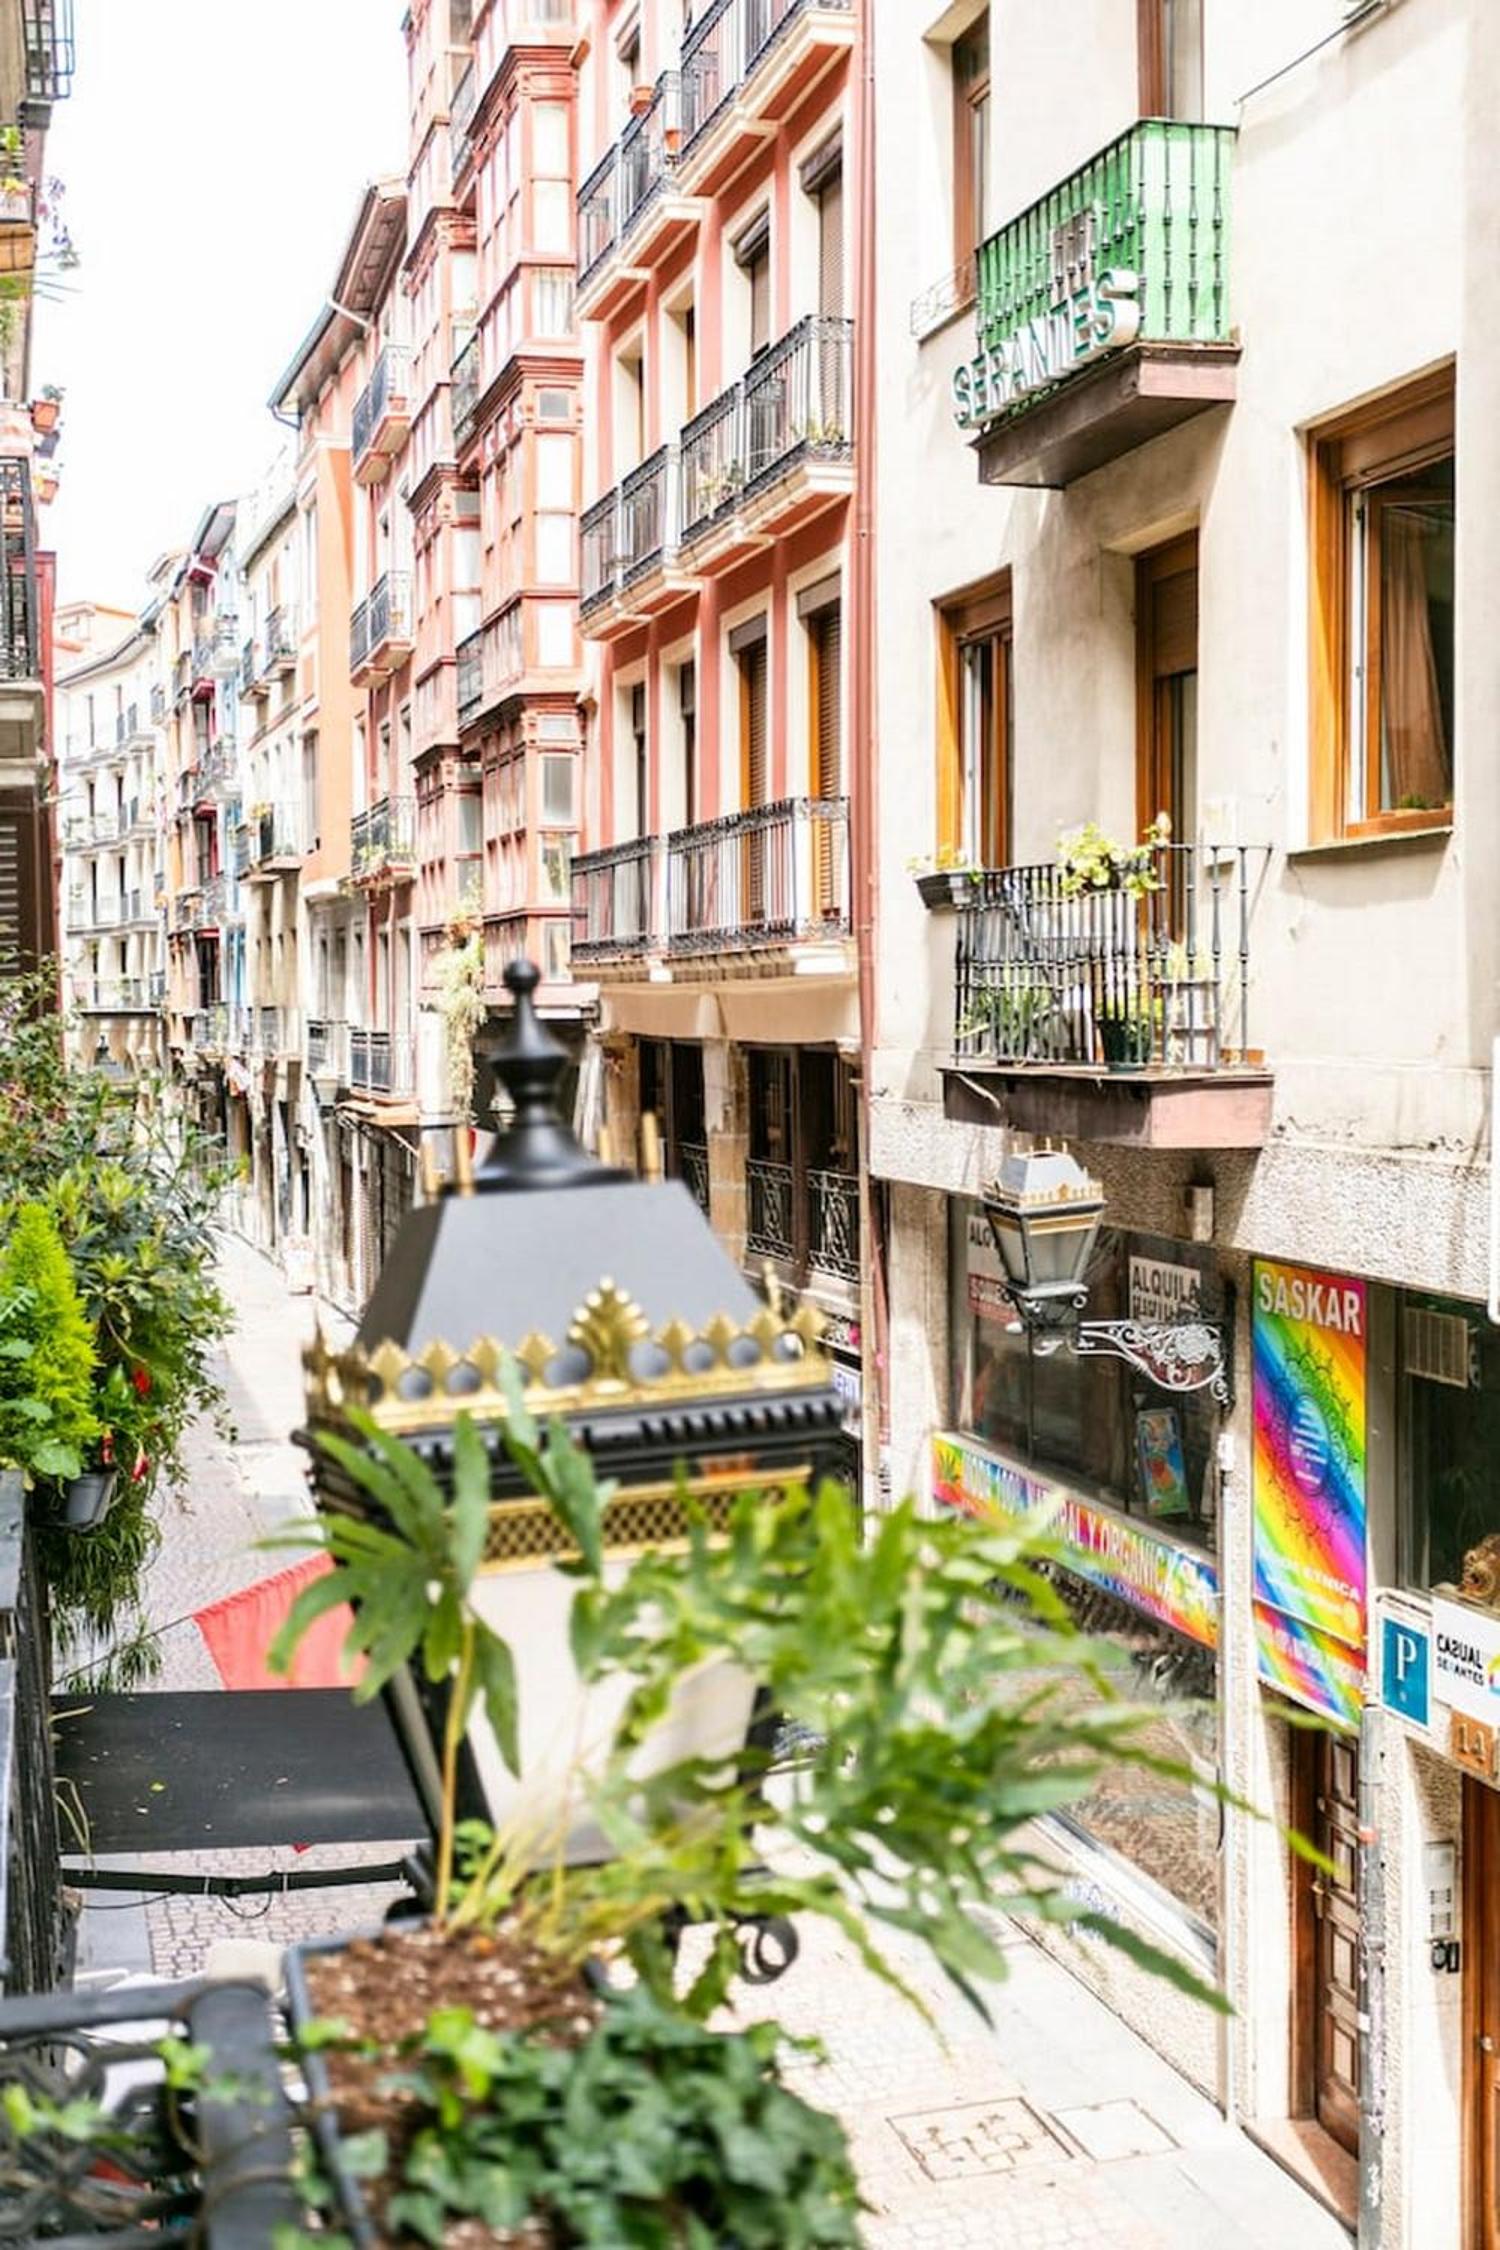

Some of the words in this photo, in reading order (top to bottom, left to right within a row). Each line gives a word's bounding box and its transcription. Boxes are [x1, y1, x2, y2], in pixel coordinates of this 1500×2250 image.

[952, 268, 1140, 430] SERANTES
[1133, 1265, 1200, 1302] ALQUILA
[1259, 1272, 1361, 1336] SASKAR
[1396, 1633, 1417, 1681] P
[1436, 1633, 1483, 1670] CASUAL
